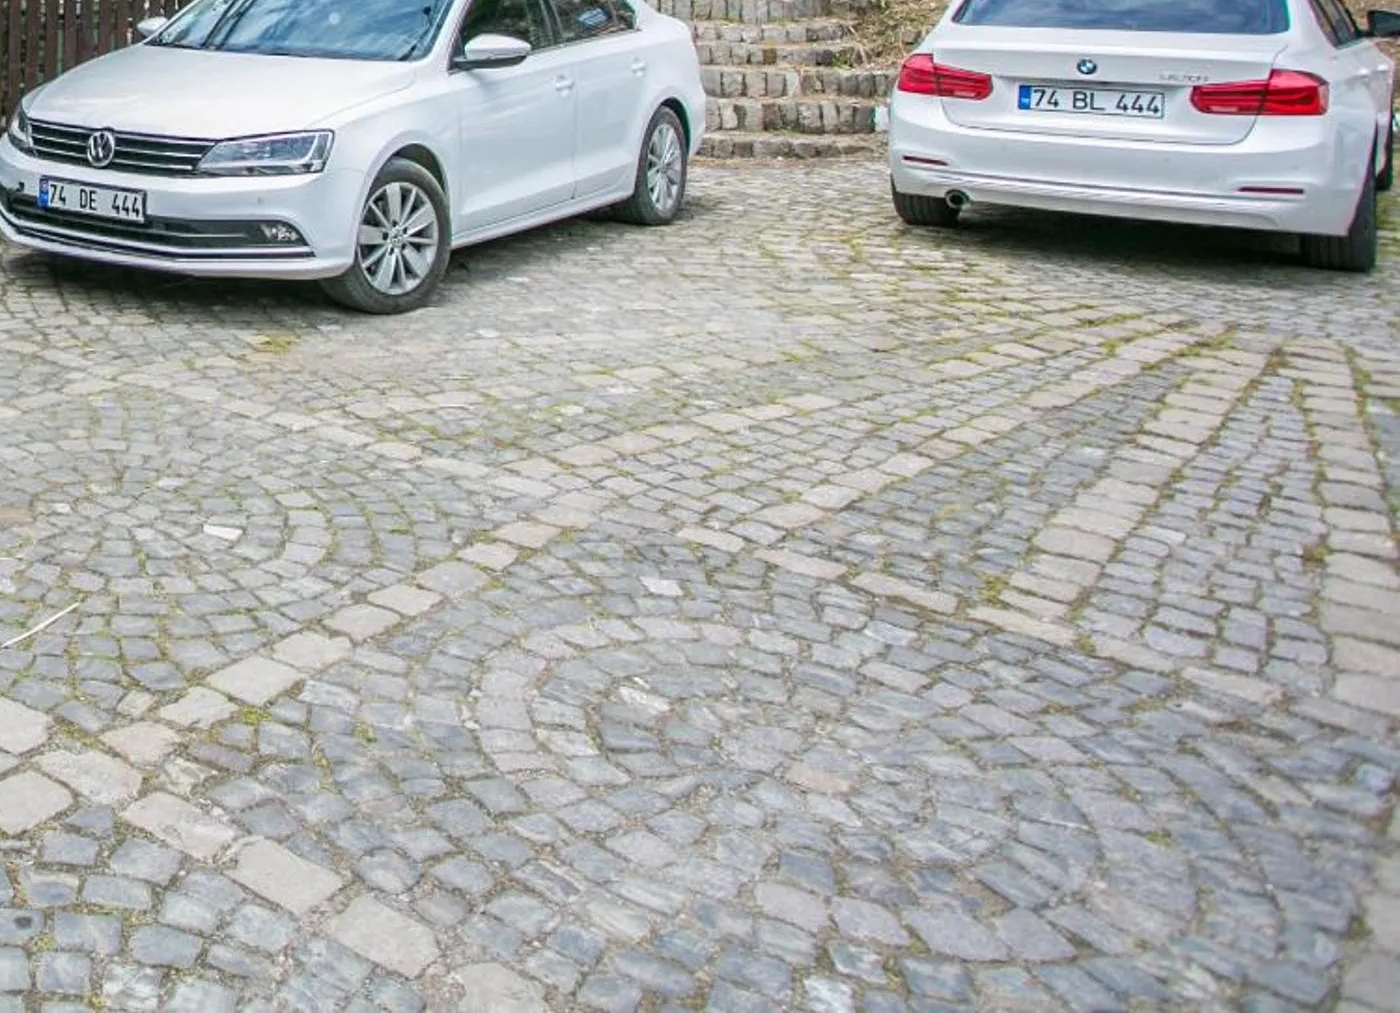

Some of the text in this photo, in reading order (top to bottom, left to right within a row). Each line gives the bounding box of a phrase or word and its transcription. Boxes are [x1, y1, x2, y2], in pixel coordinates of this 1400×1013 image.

[1033, 88, 1160, 115] 74 BL 444
[49, 184, 141, 217] 74 DE 444
